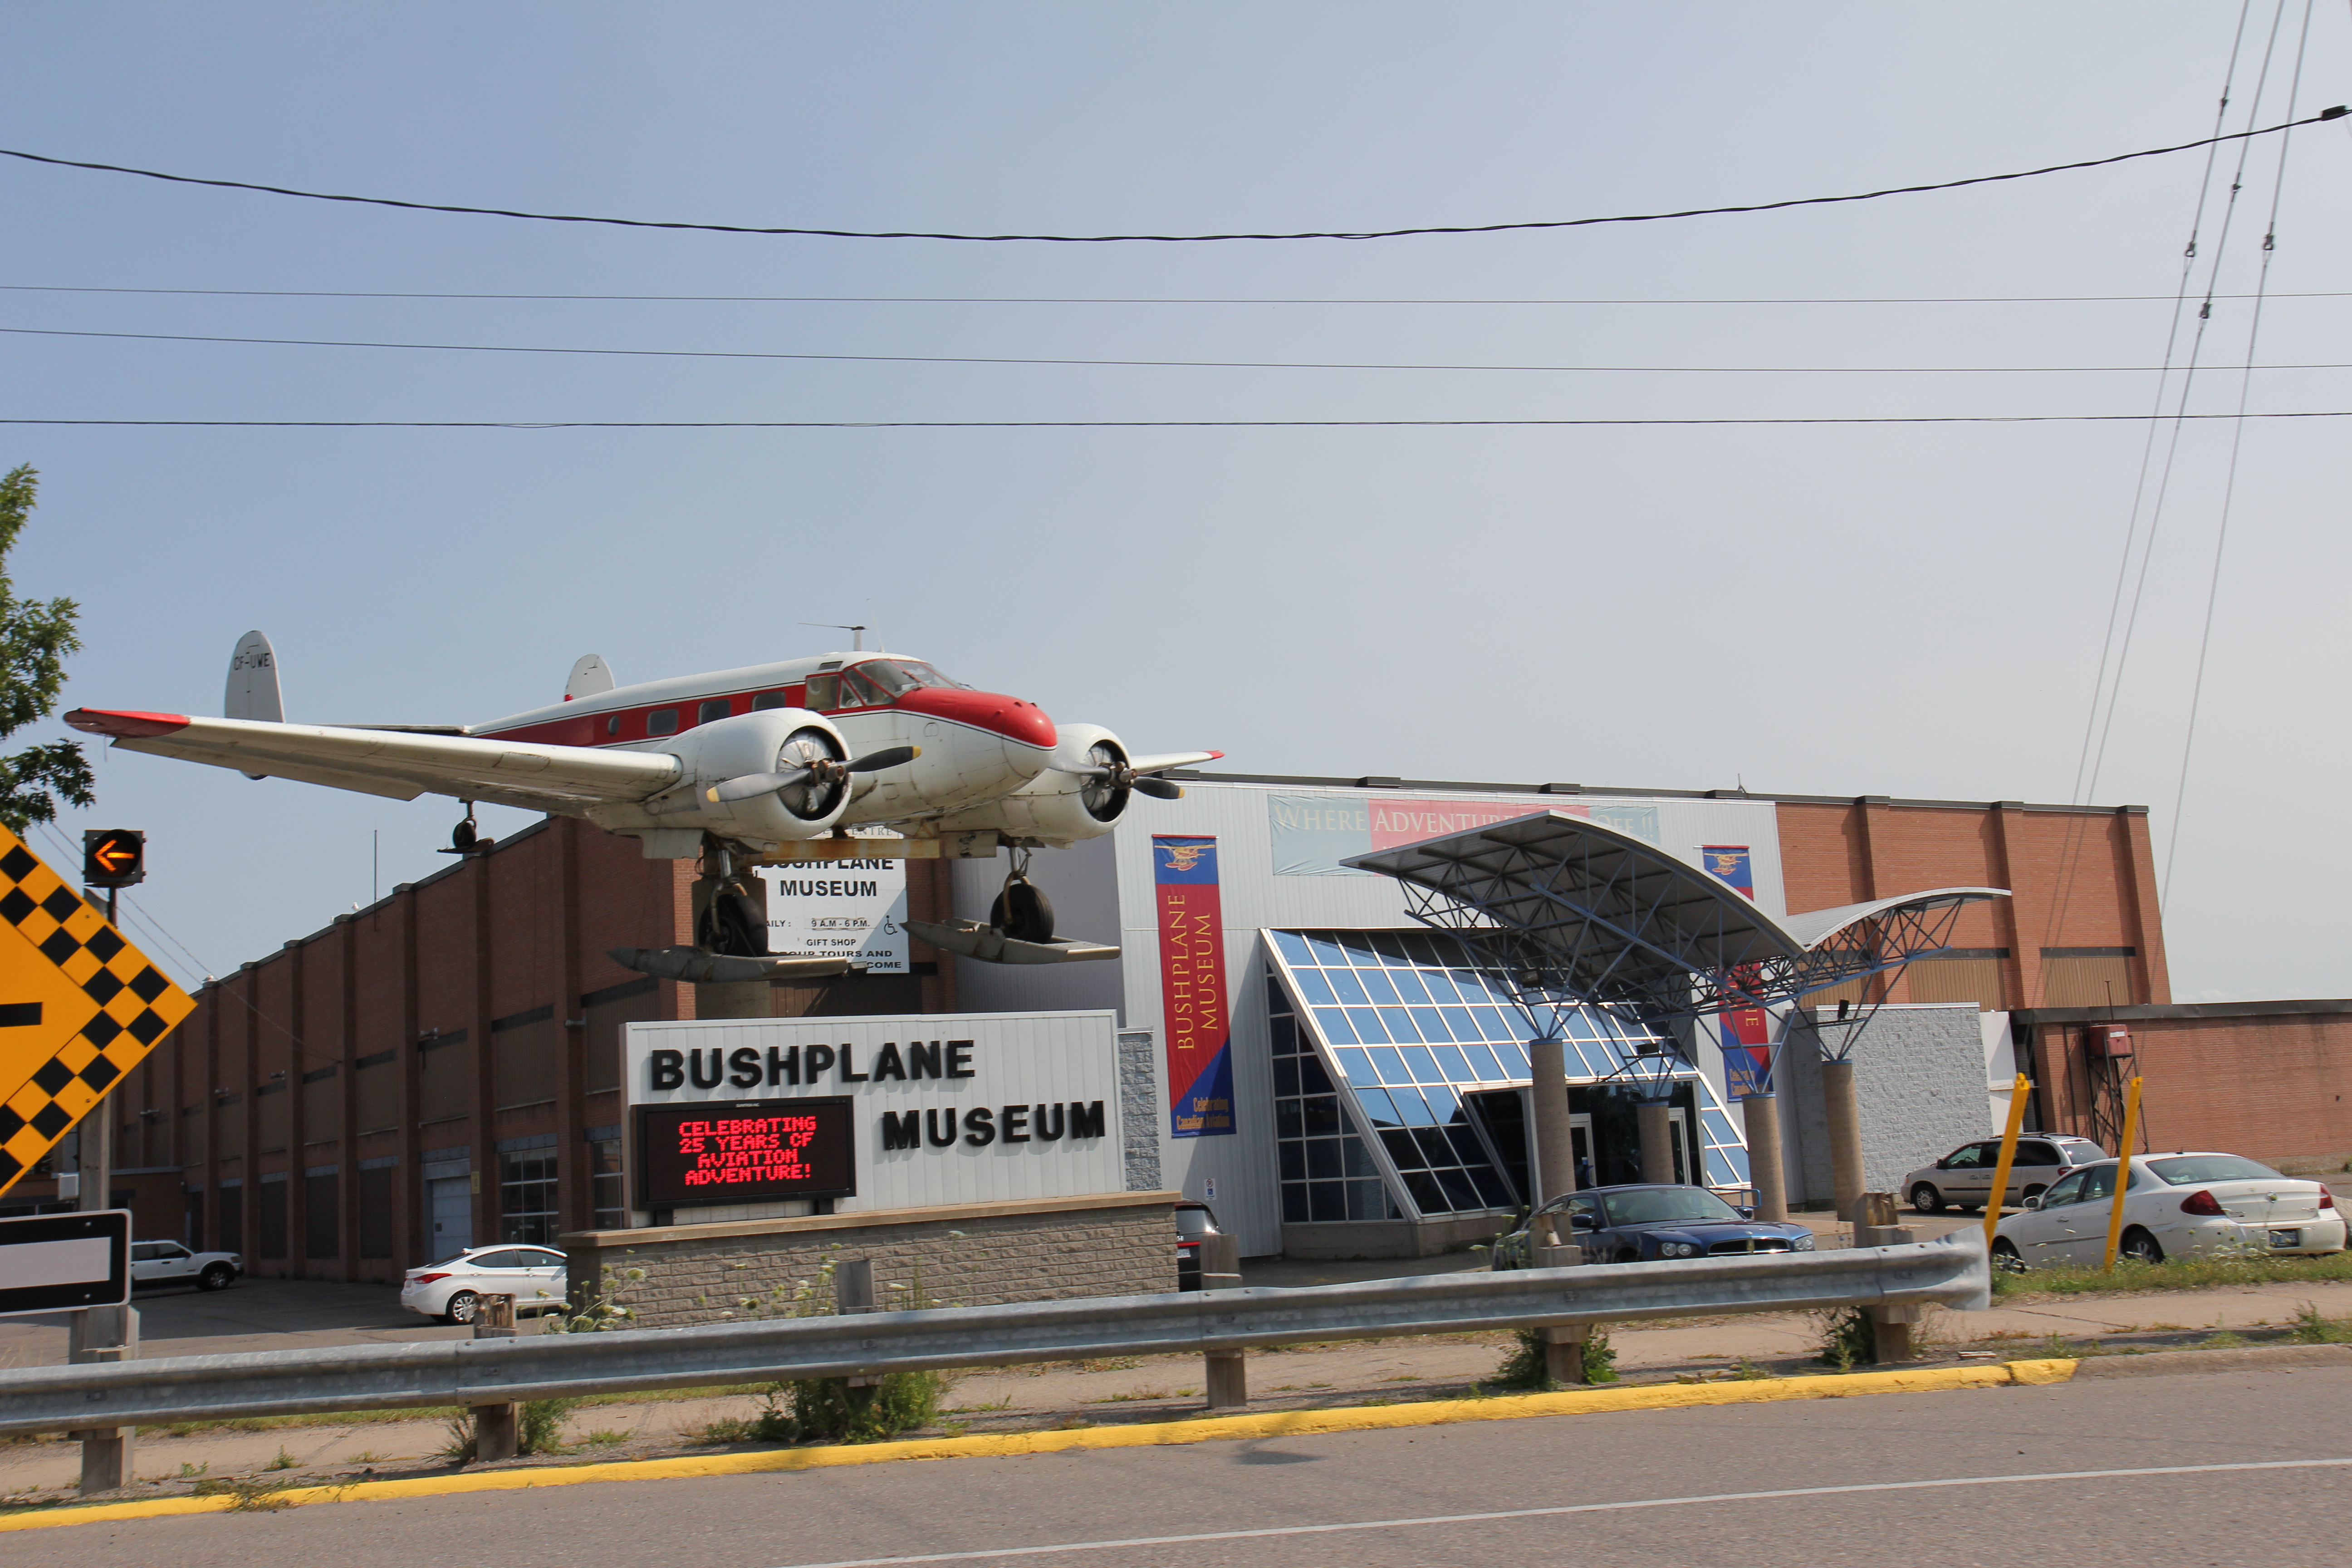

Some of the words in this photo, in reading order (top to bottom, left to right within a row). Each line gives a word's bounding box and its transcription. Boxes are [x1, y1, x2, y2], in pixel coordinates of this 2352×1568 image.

[1274, 805, 1367, 831] WHERE
[780, 880, 877, 897] MUSEUM
[1167, 895, 1195, 1049] BUSHPLANE
[1193, 912, 1218, 1030] MUSEUM
[652, 1040, 975, 1090] BUSHPLANE
[679, 1116, 816, 1137] CELEBRATING
[883, 1100, 1105, 1150] MUSEUM
[679, 1137, 705, 1153] 25
[714, 1133, 780, 1152] YEARS
[697, 1148, 798, 1169] AVIATION
[685, 1163, 810, 1186] ADVENTURE!
